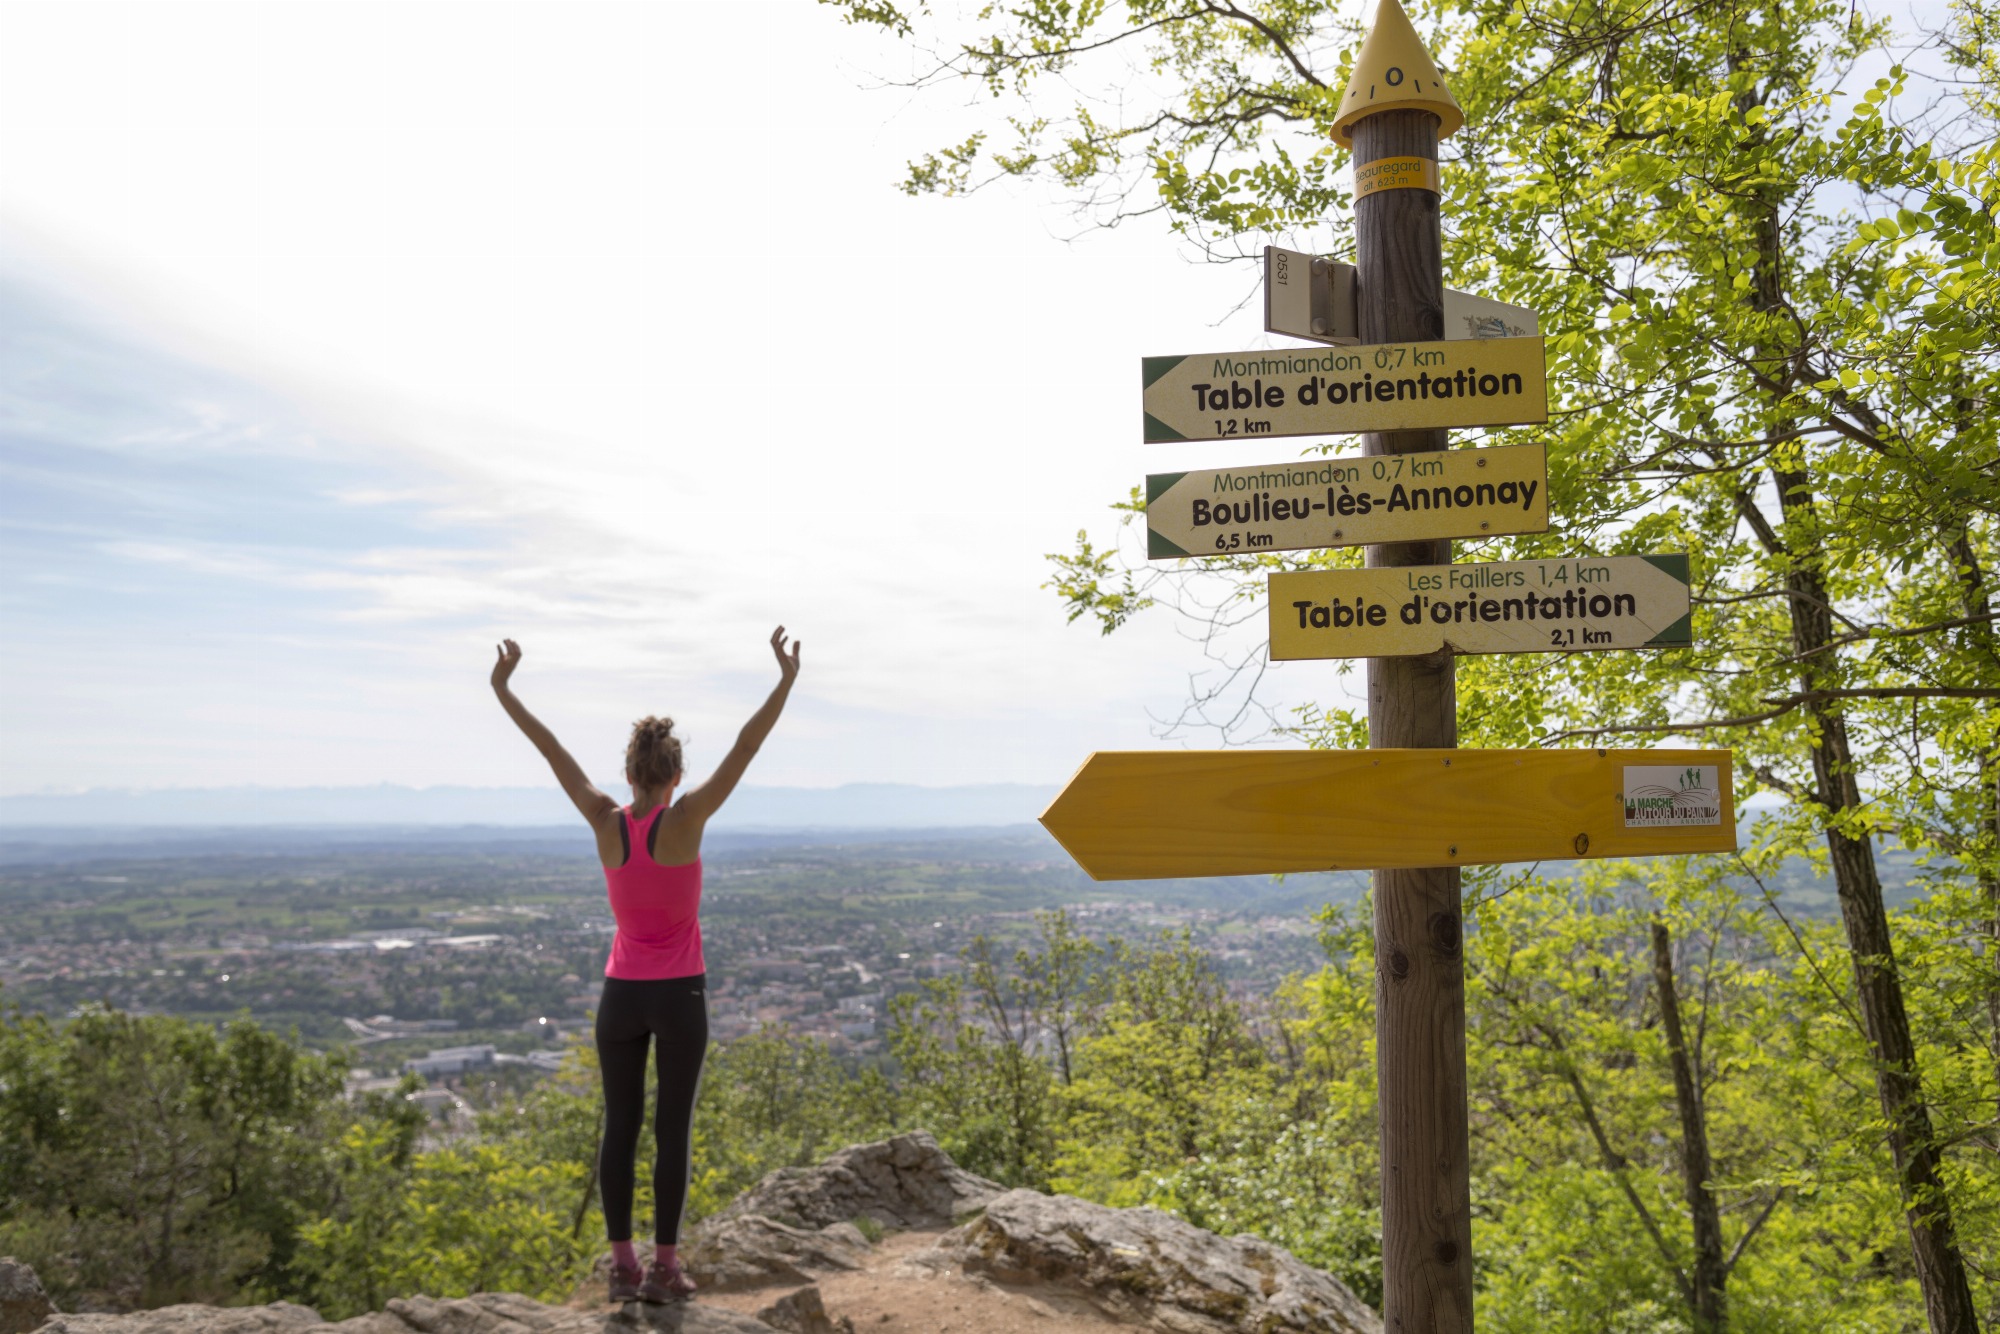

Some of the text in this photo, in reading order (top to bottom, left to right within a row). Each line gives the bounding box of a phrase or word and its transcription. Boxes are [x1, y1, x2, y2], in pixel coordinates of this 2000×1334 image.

[1355, 160, 1421, 184] Beauregard
[1378, 176, 1396, 186] 623
[1277, 254, 1287, 285] 0531
[1213, 347, 1445, 378] Montmiandon 0,7 km
[1191, 367, 1522, 411] Table d'orientation
[1215, 418, 1271, 437] 1,2 km
[1214, 457, 1443, 493] Montmiandon 0,7 km
[1192, 480, 1538, 526] Boulieu-lès-Annonay
[1215, 532, 1273, 551] 6,5 km
[1408, 562, 1610, 591] Les Faillers 1,4 km
[1292, 587, 1635, 629] Table d'orientation
[1551, 627, 1612, 647] 2,1 km
[1625, 798, 1674, 809] LA MARCHE
[1634, 807, 1704, 819] AUTOUR DU PAIN
